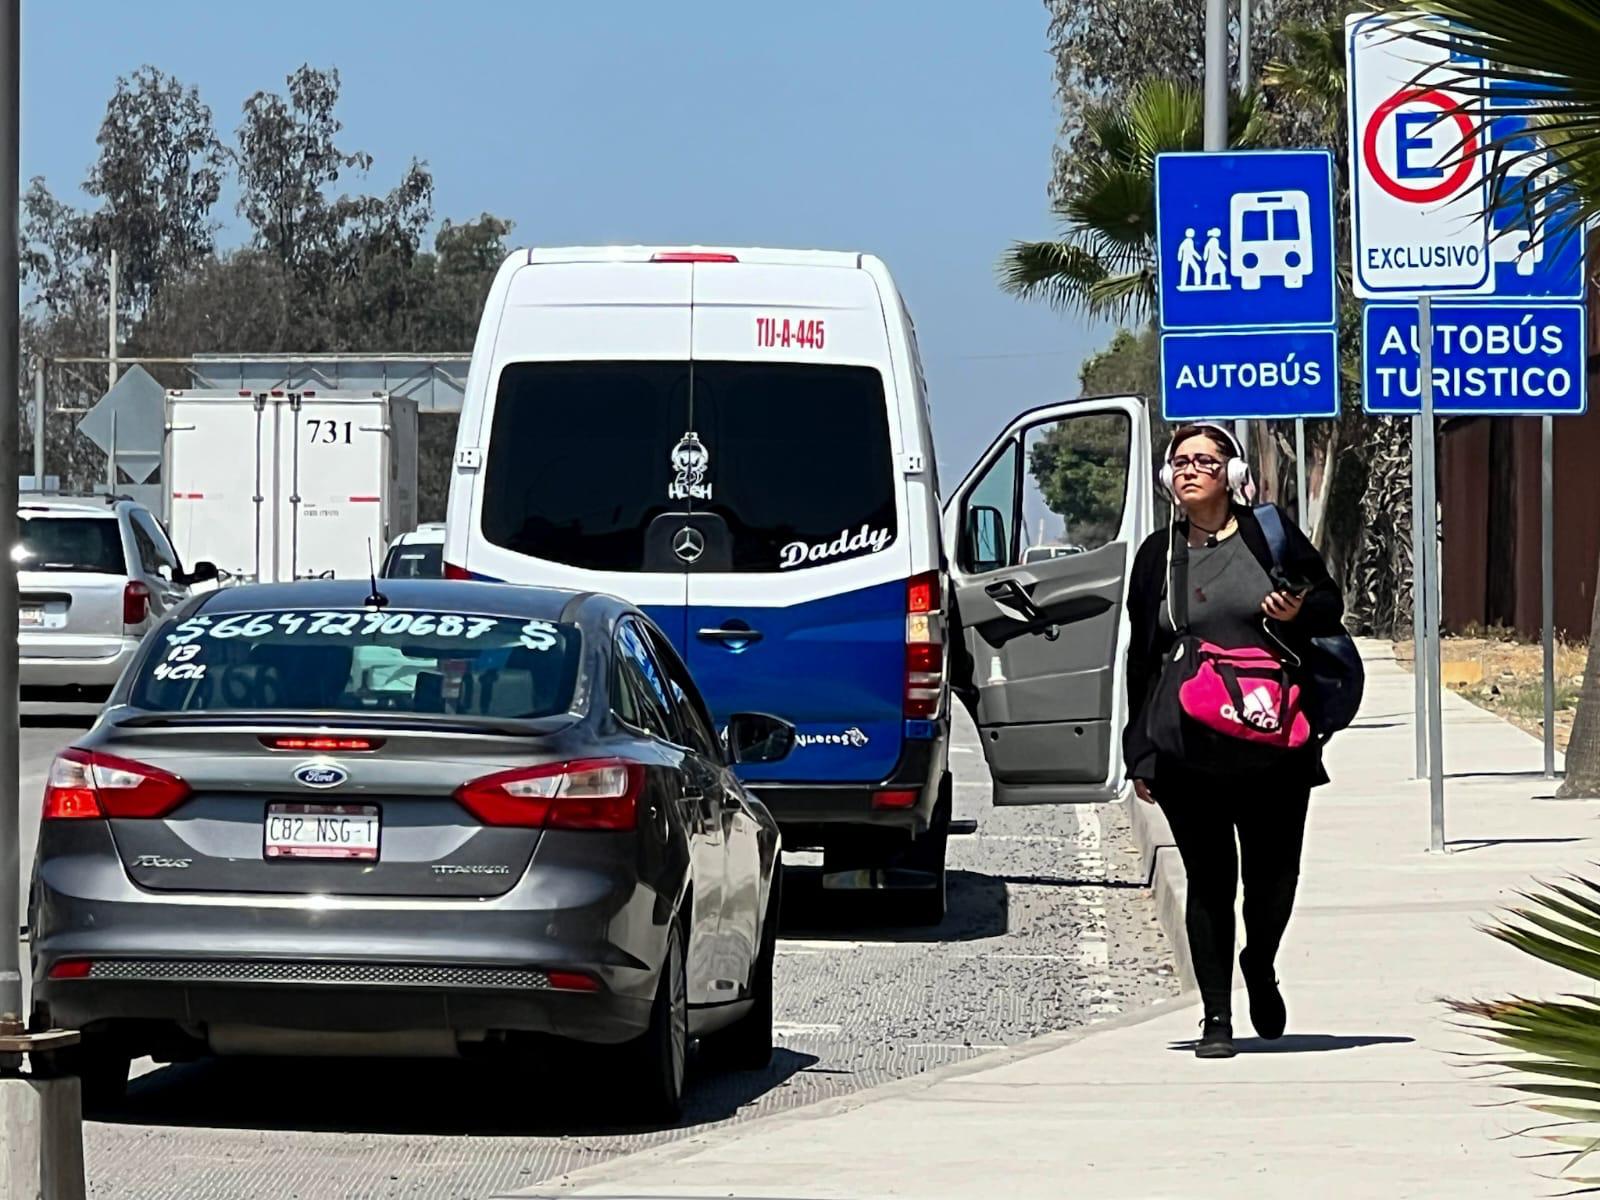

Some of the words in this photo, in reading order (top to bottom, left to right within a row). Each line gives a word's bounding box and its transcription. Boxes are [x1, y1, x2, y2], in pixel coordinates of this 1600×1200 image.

[1395, 112, 1444, 179] E
[1367, 245, 1479, 269] EXCLUSIVO
[756, 318, 825, 349] TIJ-A-445
[1379, 314, 1563, 355] AUTOBÚS
[1175, 353, 1321, 389] AUTOBÚS
[1376, 367, 1571, 397] TURISTICO
[306, 420, 352, 444] 731
[779, 524, 891, 568] Daddy
[305, 769, 335, 782] Ford
[270, 817, 304, 841] C82
